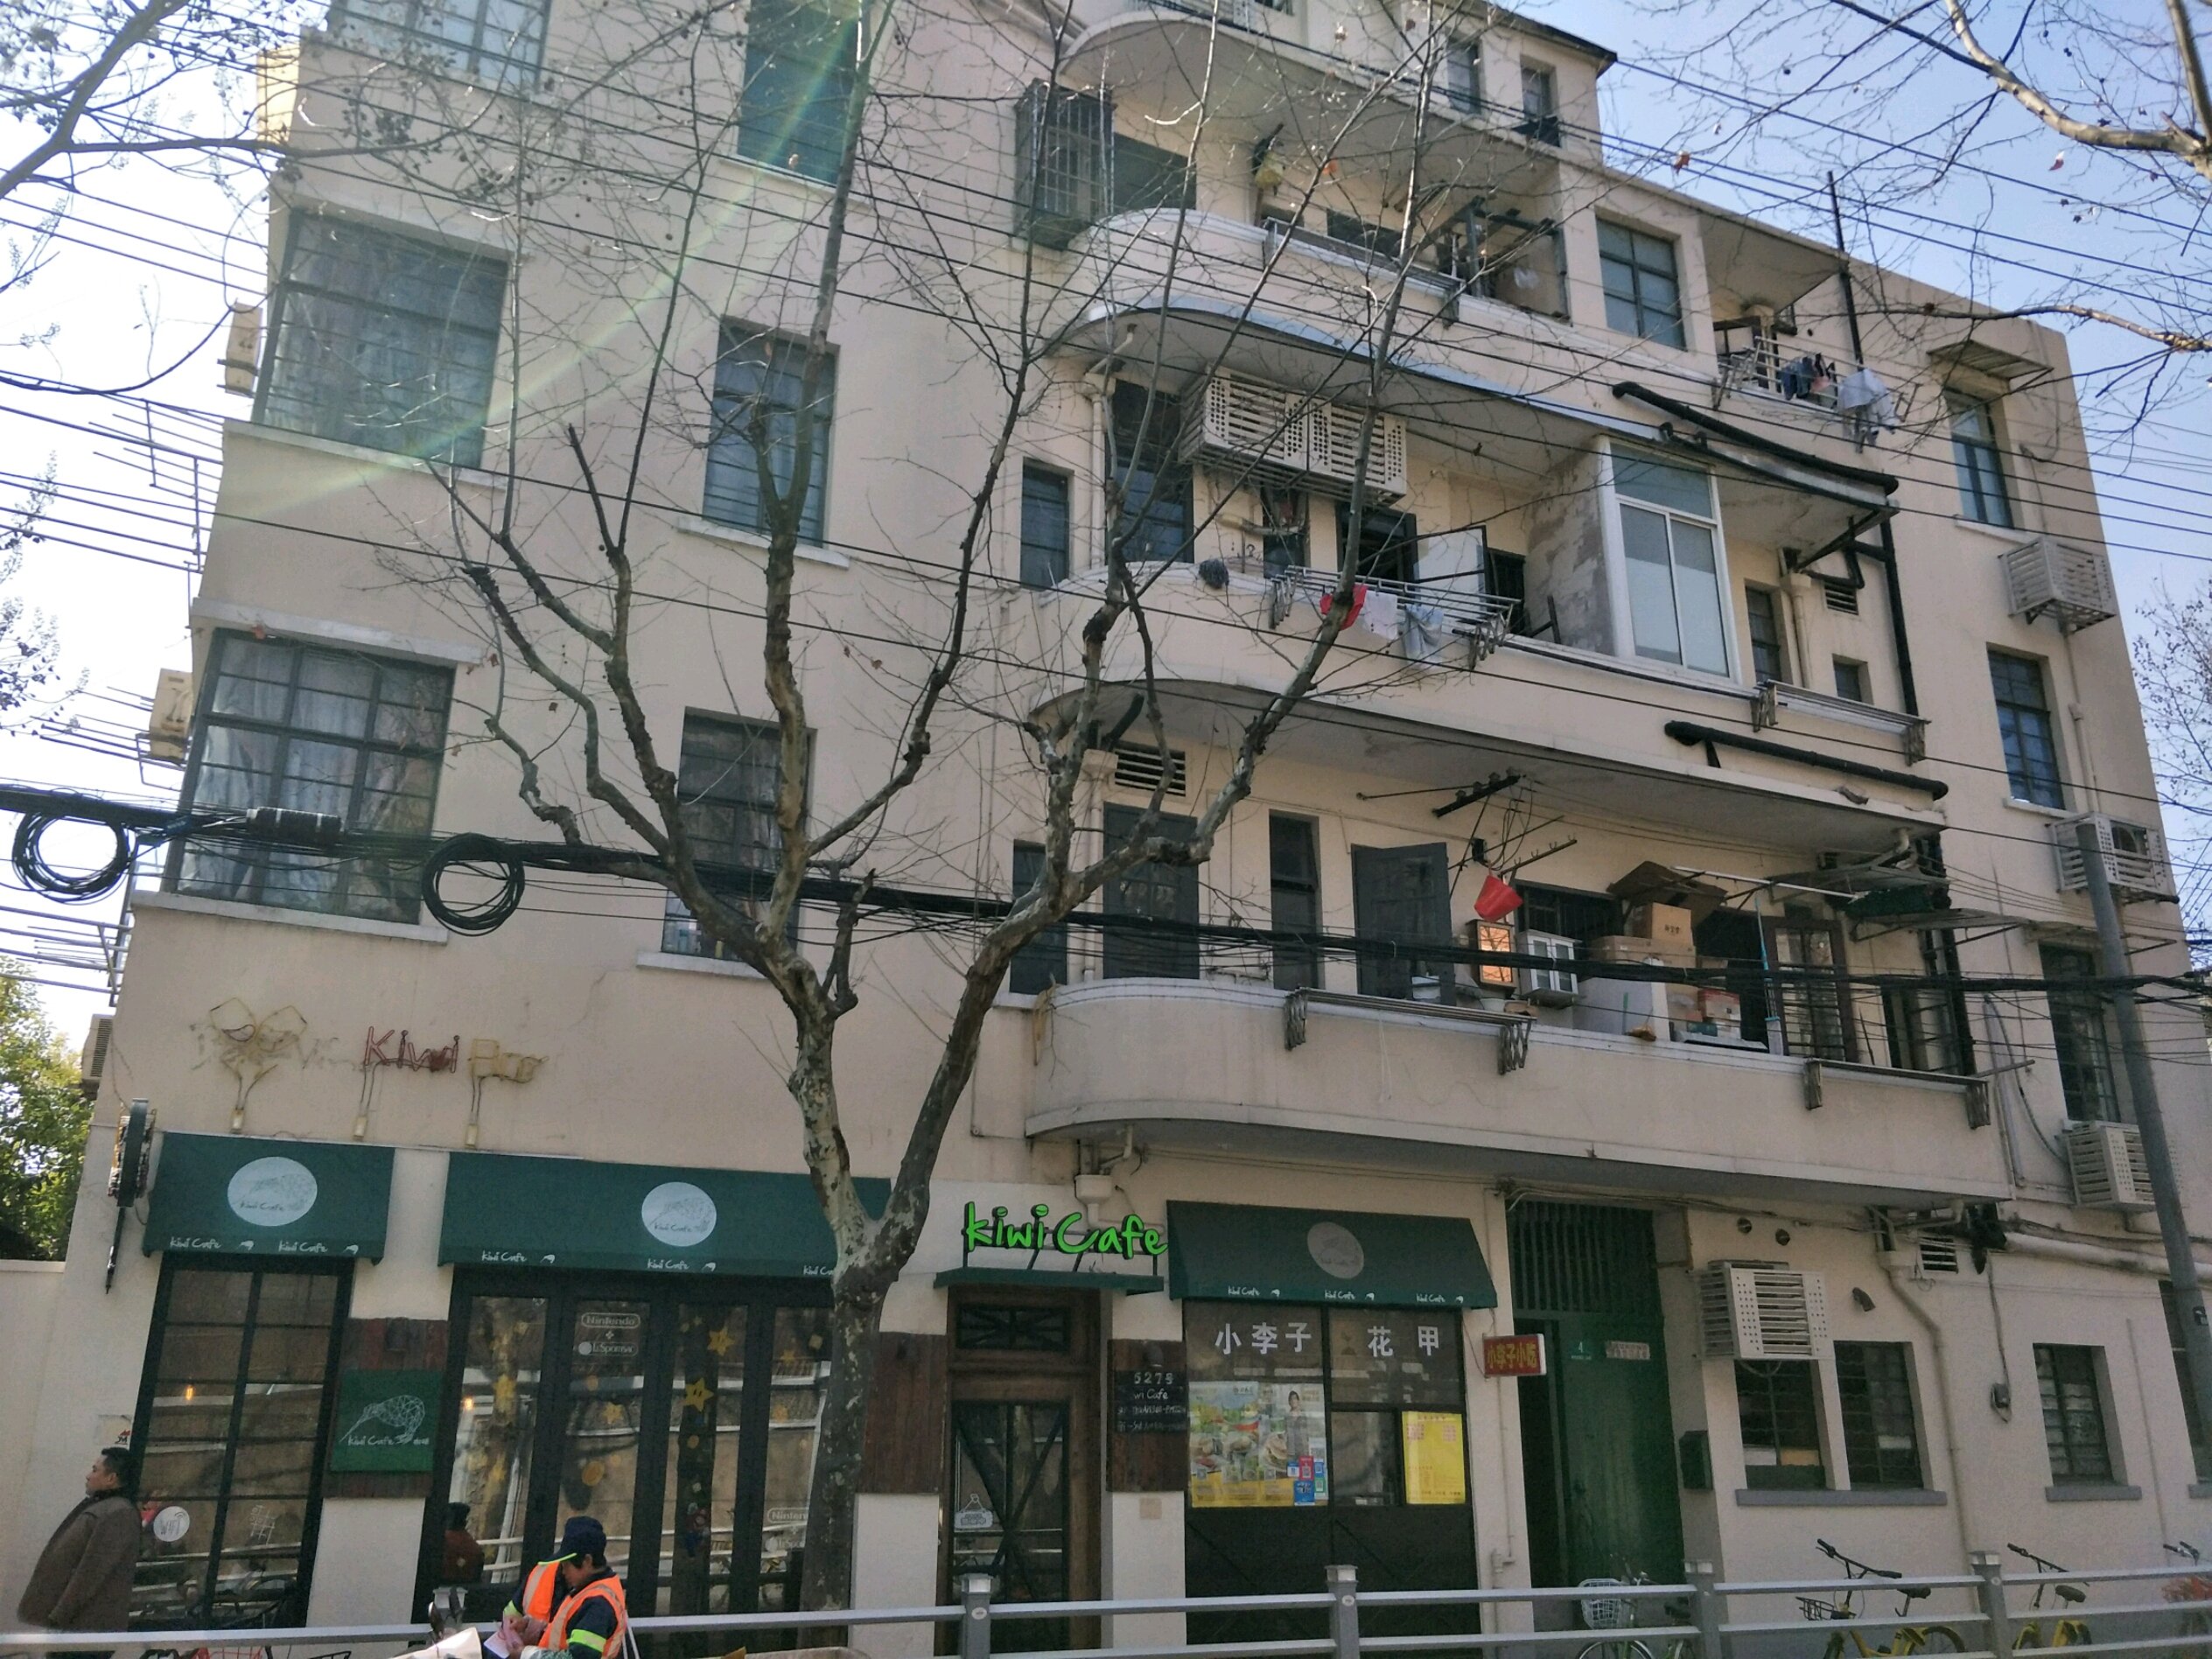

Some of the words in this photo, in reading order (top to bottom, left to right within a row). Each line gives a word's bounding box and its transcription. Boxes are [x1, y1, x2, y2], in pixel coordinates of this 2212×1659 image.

[1053, 1212, 1168, 1260] Cafe
[192, 1237, 222, 1250] Cafe
[299, 1241, 328, 1254] Cafe
[500, 1251, 527, 1263] Cafe
[665, 1259, 690, 1270] Cafe
[586, 1316, 635, 1326] Nintendo
[1214, 1321, 1312, 1355] 小李子
[1367, 1325, 1439, 1357] 花甲
[1487, 1341, 1537, 1369] 小李子小吃
[1146, 1388, 1169, 1401] Cafe
[772, 1511, 807, 1521] Ninten
